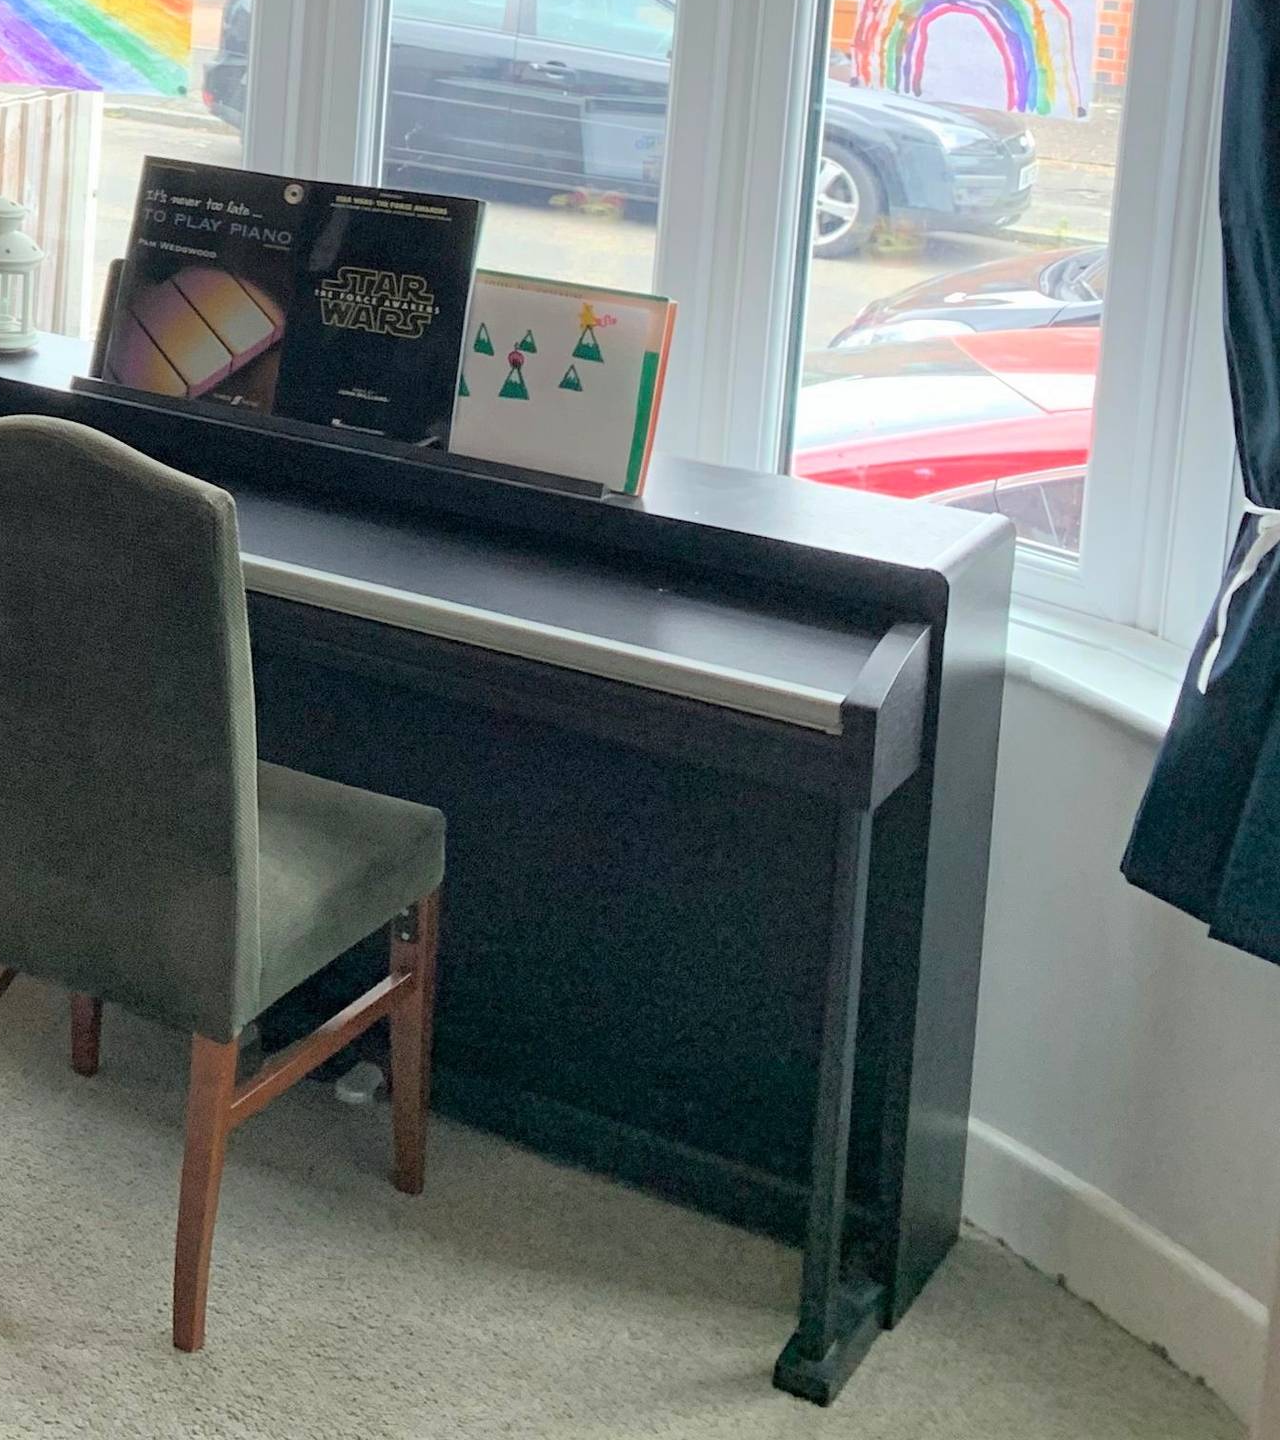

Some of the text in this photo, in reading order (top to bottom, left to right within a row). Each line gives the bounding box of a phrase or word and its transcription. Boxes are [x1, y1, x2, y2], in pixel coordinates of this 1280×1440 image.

[206, 197, 224, 211] too
[142, 210, 292, 245] TO PLAY PIANO
[321, 266, 435, 305] STAR
[320, 298, 432, 339] WARS
[340, 292, 377, 306] FORCE
[384, 299, 440, 315] AWAKENS
